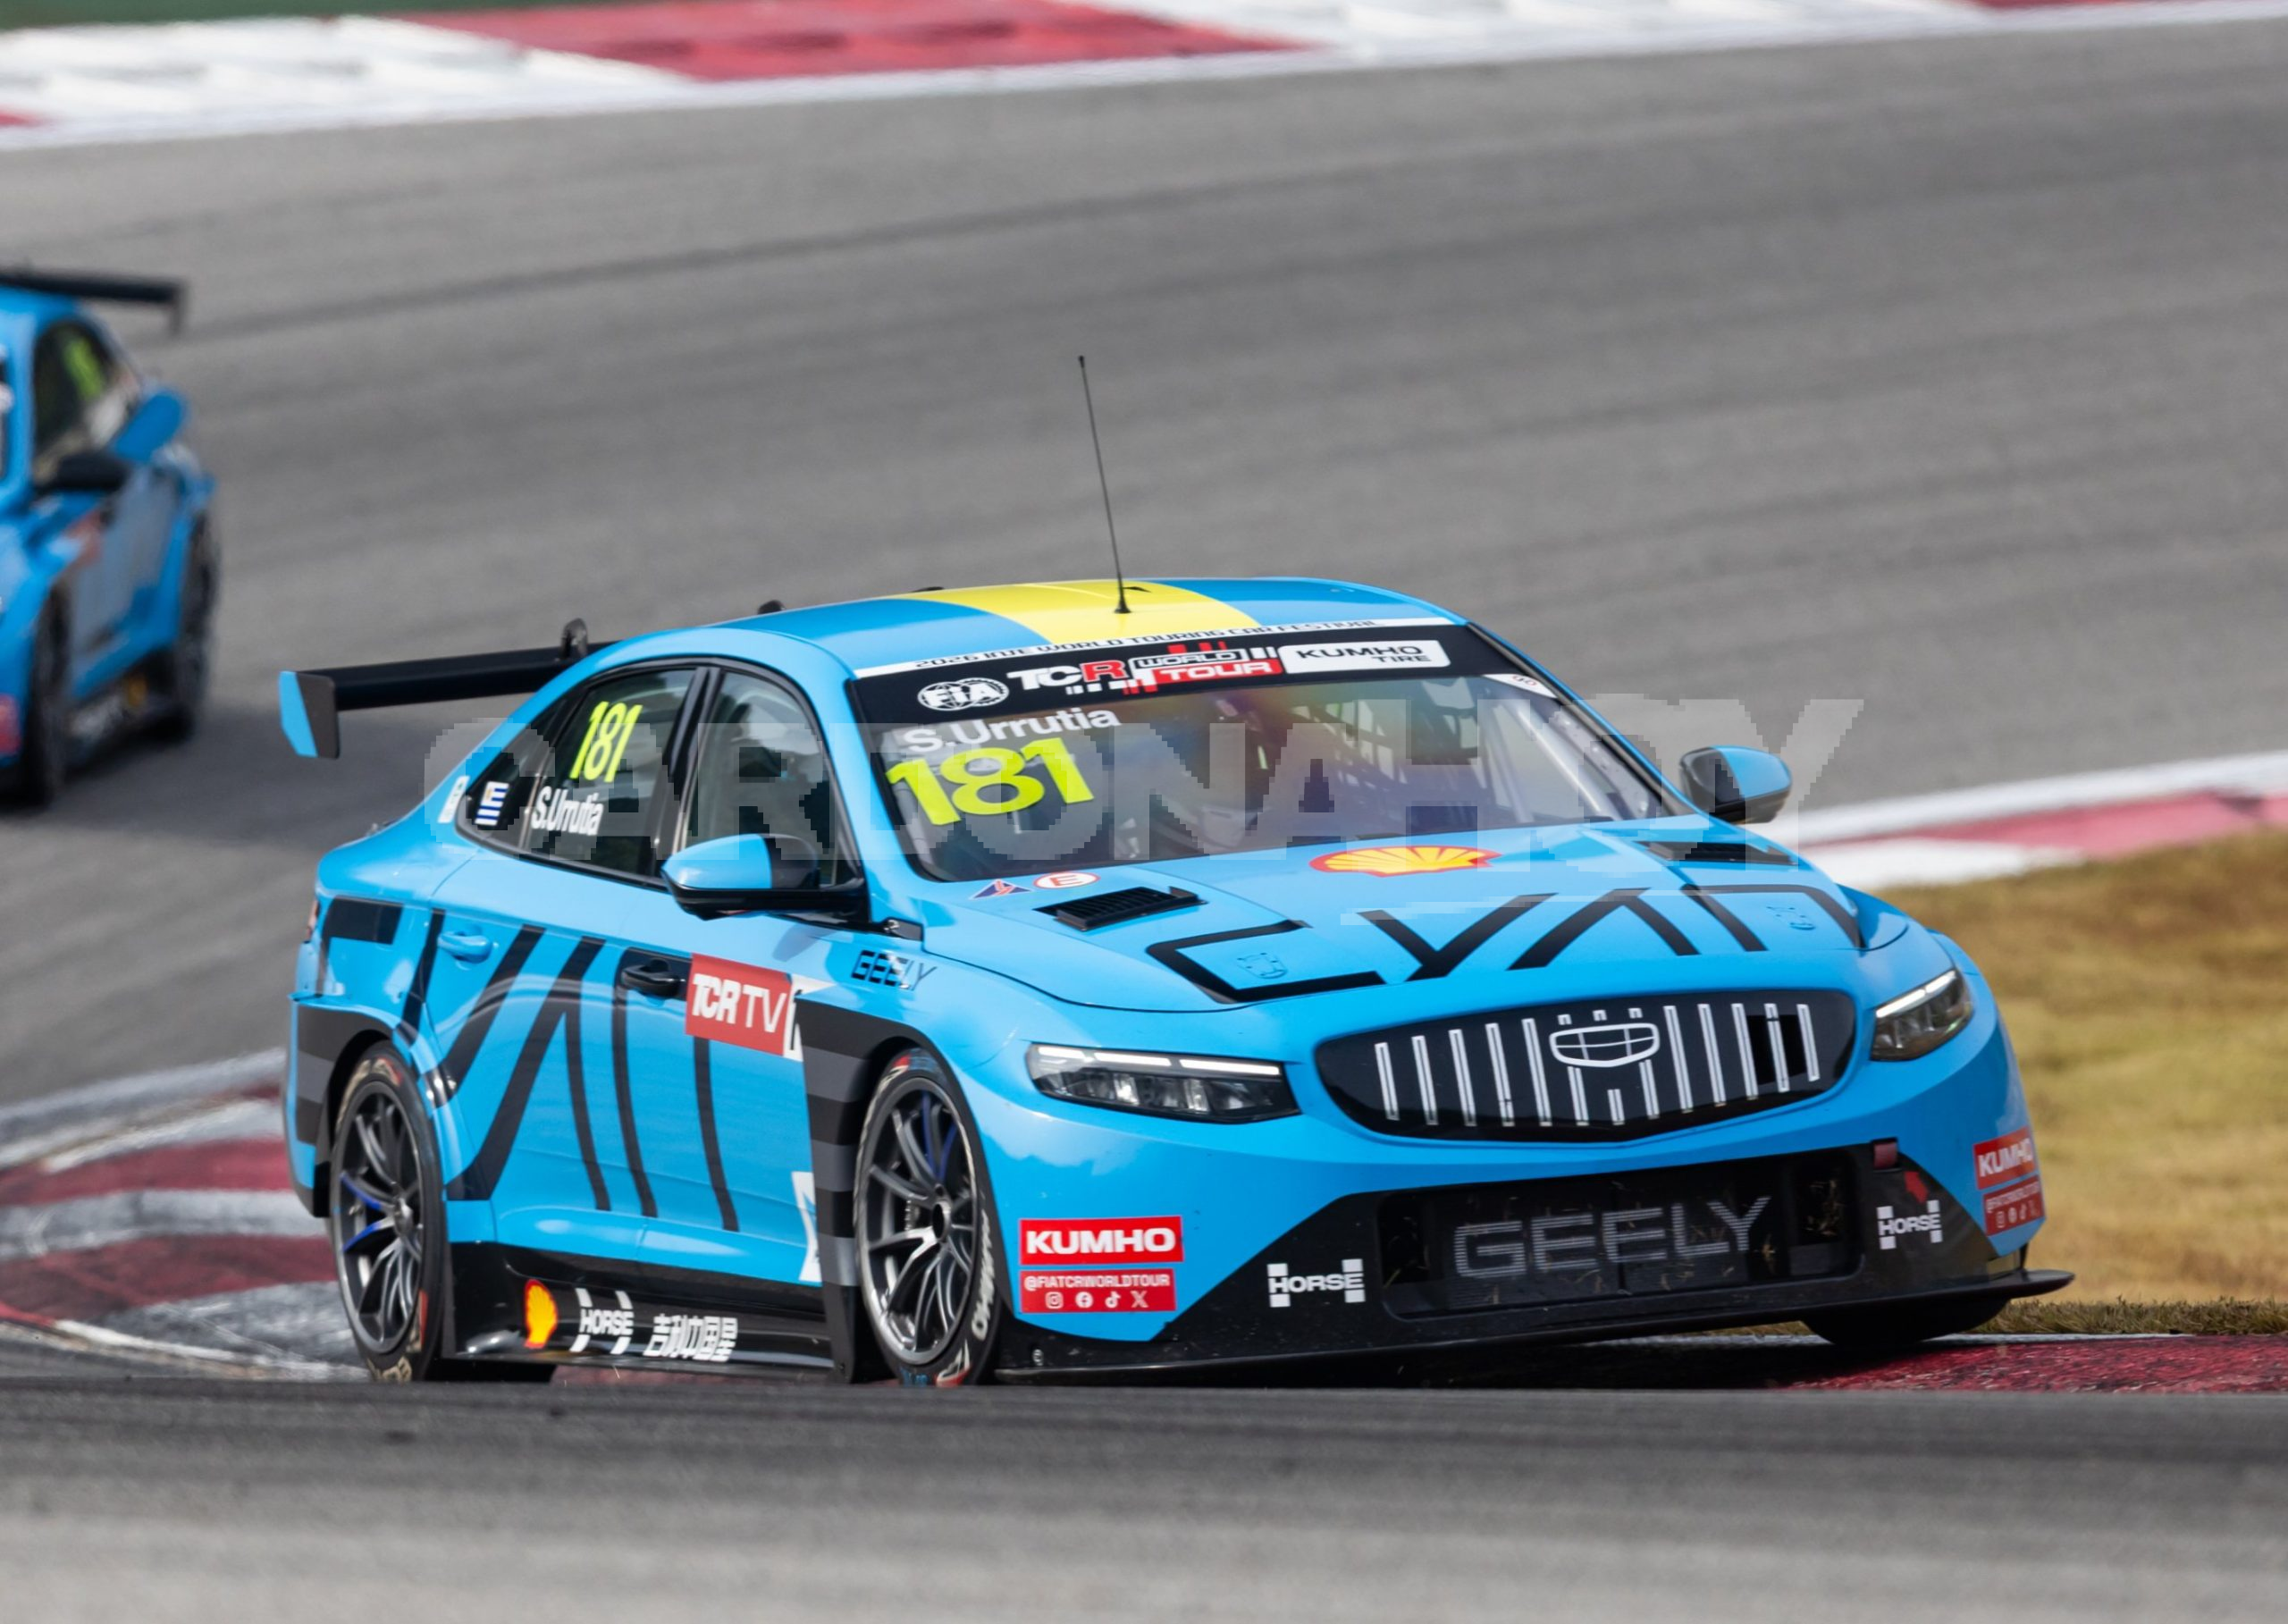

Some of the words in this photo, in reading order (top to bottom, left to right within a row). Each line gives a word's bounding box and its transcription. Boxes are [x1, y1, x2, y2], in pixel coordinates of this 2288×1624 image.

[915, 654, 979, 668] 2026
[1038, 638, 1126, 652] WORLD
[1130, 628, 1226, 644] TOURING
[1230, 626, 1270, 635] CAR
[1282, 620, 1376, 633] FESTIVAL
[1138, 650, 1237, 669] WORLD
[1296, 645, 1424, 660] KUMHO
[1371, 655, 1432, 664] TIRE
[1006, 660, 1130, 691] TCR
[1159, 661, 1274, 681] TOUR
[569, 701, 643, 783] 181
[903, 707, 1123, 753] S.Urrutia
[885, 736, 1095, 826] 181
[851, 950, 938, 991] GEELY
[1026, 1227, 1176, 1255] KUMHO
[1454, 1196, 1771, 1278] GEELY
[1024, 1274, 1171, 1291] @FIATCRWORLDTOUR
